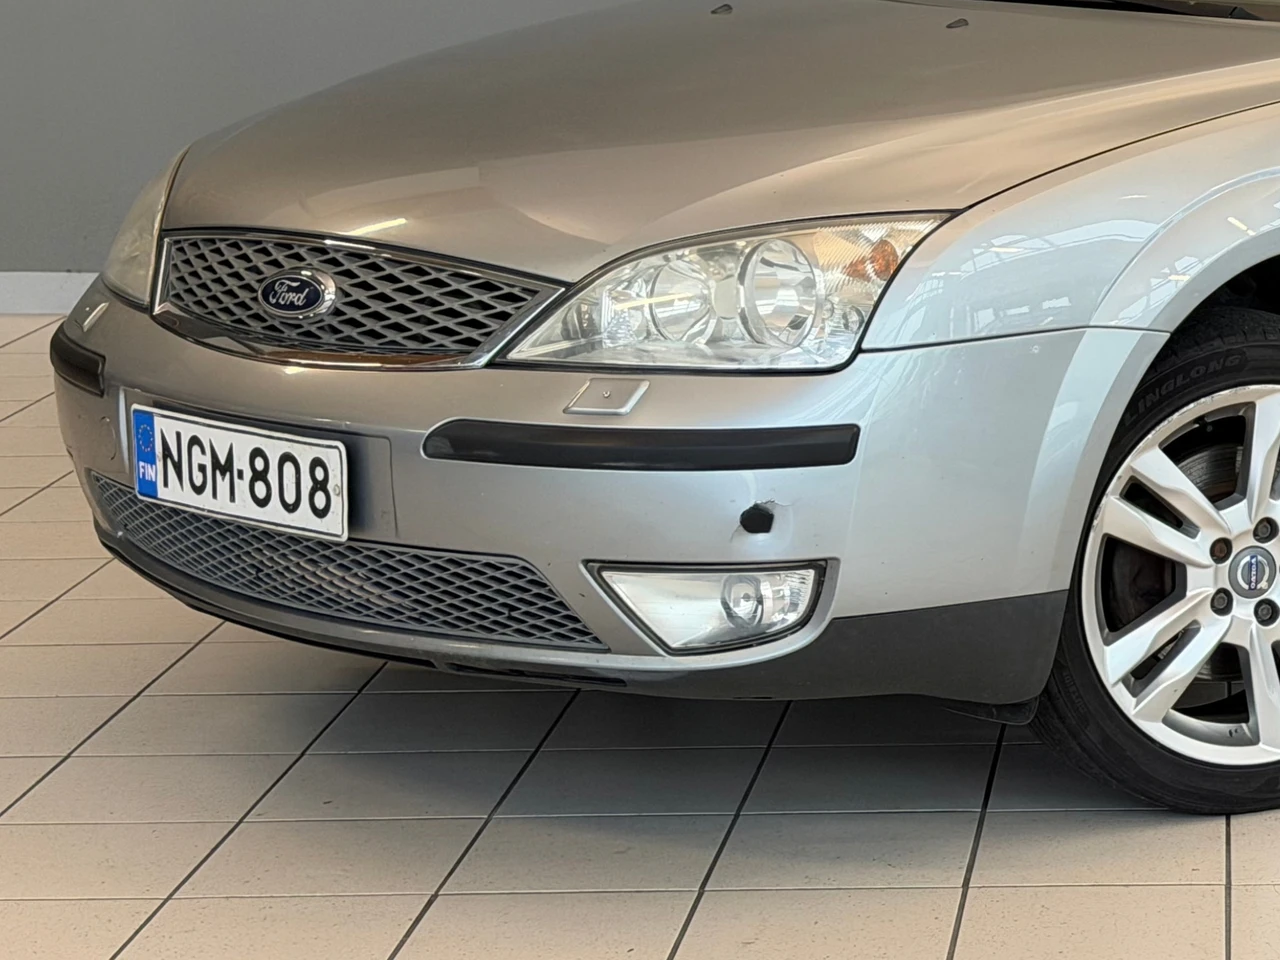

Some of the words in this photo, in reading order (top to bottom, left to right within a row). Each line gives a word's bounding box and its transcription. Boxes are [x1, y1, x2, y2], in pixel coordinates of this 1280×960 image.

[269, 279, 309, 307] Ford
[1125, 354, 1241, 426] LINGLONG
[139, 460, 156, 482] FIN
[160, 427, 332, 519] NGM-808
[1249, 555, 1258, 589] VOLVO
